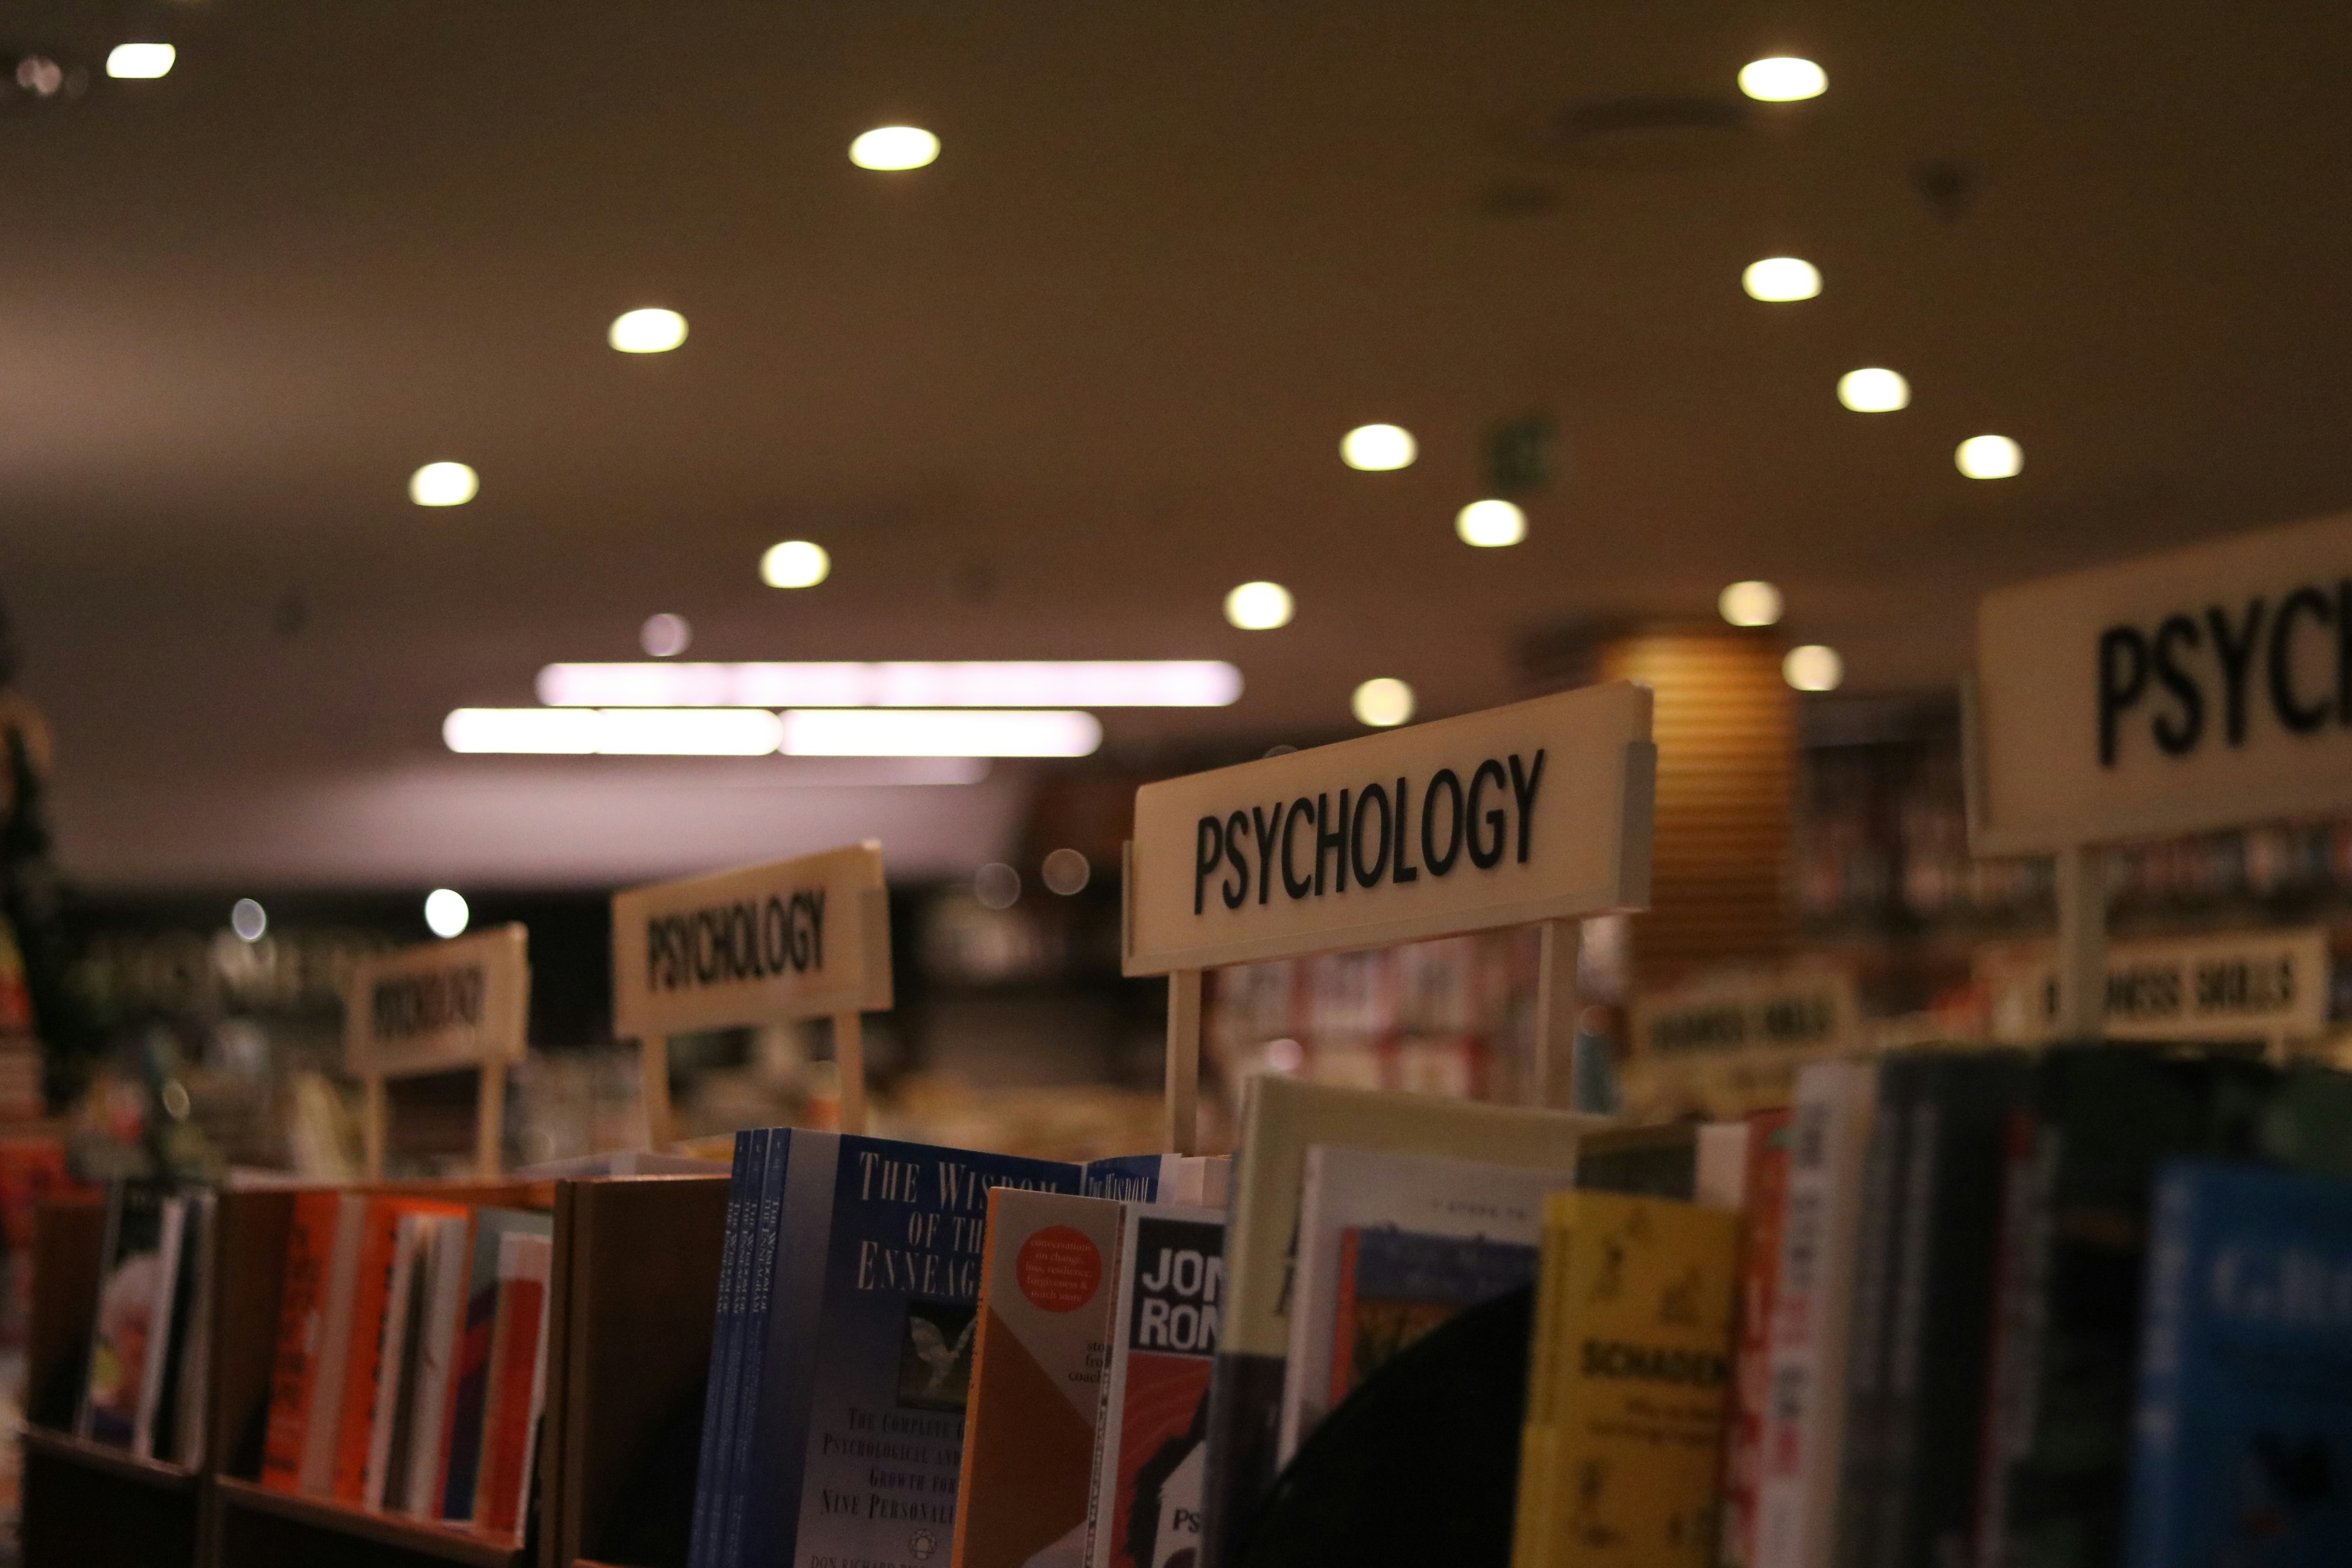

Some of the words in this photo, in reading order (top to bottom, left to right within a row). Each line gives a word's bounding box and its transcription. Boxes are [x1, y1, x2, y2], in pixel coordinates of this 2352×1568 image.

[1194, 749, 1544, 915] PSYCHOLOGY
[648, 884, 825, 993] PSYCHOLOGY
[860, 1151, 921, 1203] THE
[937, 1159, 1057, 1211] WIS
[907, 1211, 941, 1249] OF
[952, 1216, 985, 1255] TH
[1030, 1240, 1092, 1251] conversations
[858, 1240, 978, 1298] ENNEAG
[1027, 1275, 1078, 1288] forgiveness
[1080, 1281, 1087, 1289] &
[1031, 1290, 1059, 1299] much
[1139, 1298, 1217, 1351] RON
[1085, 1353, 1103, 1368] fro
[1087, 1341, 1105, 1353] sto
[848, 1407, 876, 1431] THE
[881, 1413, 950, 1438] COMPLETE
[822, 1432, 929, 1464] PSYCHOLOGICAL
[936, 1449, 961, 1467] AND
[869, 1466, 926, 1492] GROWTH
[931, 1476, 956, 1495] FOR
[820, 1488, 861, 1515] NINE
[868, 1493, 954, 1525] PERSONALI
